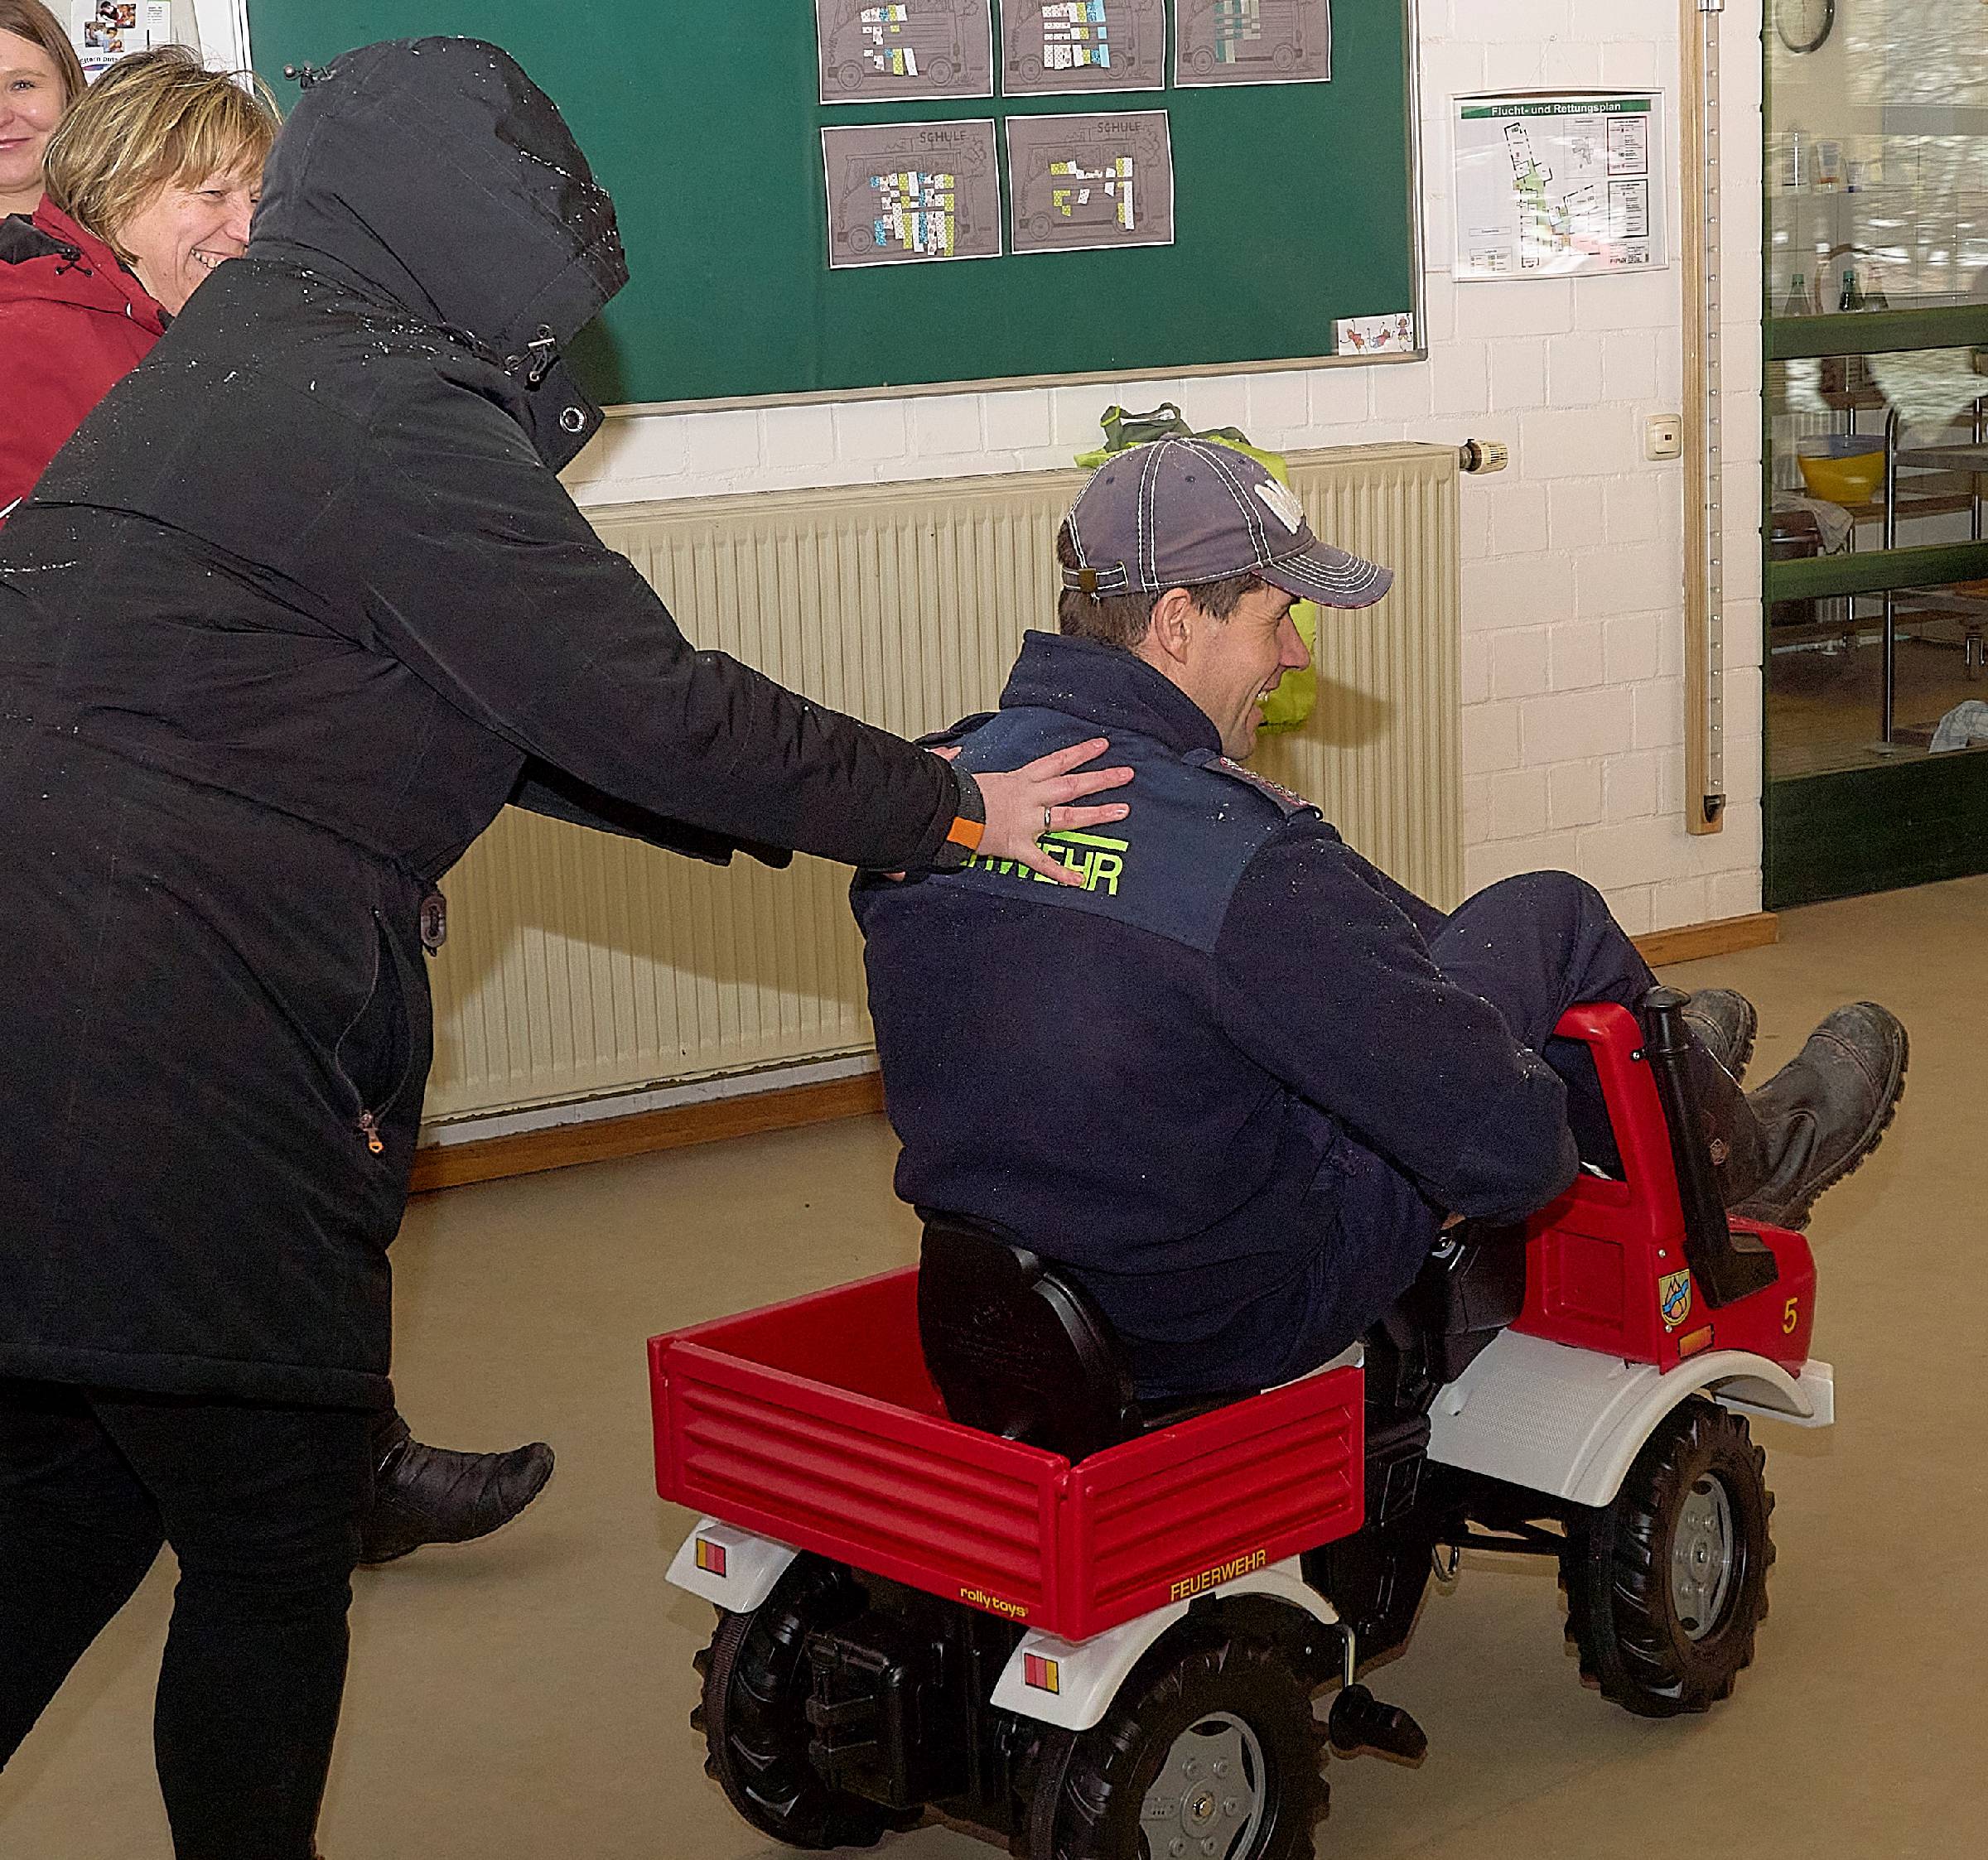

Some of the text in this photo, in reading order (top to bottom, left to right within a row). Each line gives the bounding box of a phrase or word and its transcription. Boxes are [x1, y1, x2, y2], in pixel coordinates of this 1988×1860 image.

[1491, 102, 1621, 117] Flucht- und Rettungsplan
[1098, 122, 1142, 133] SCHULE
[919, 130, 967, 143] SCHULE
[1783, 1297, 1798, 1334] 5
[1170, 1549, 1267, 1602] FEUERWEHR
[960, 1588, 991, 1608] rolly
